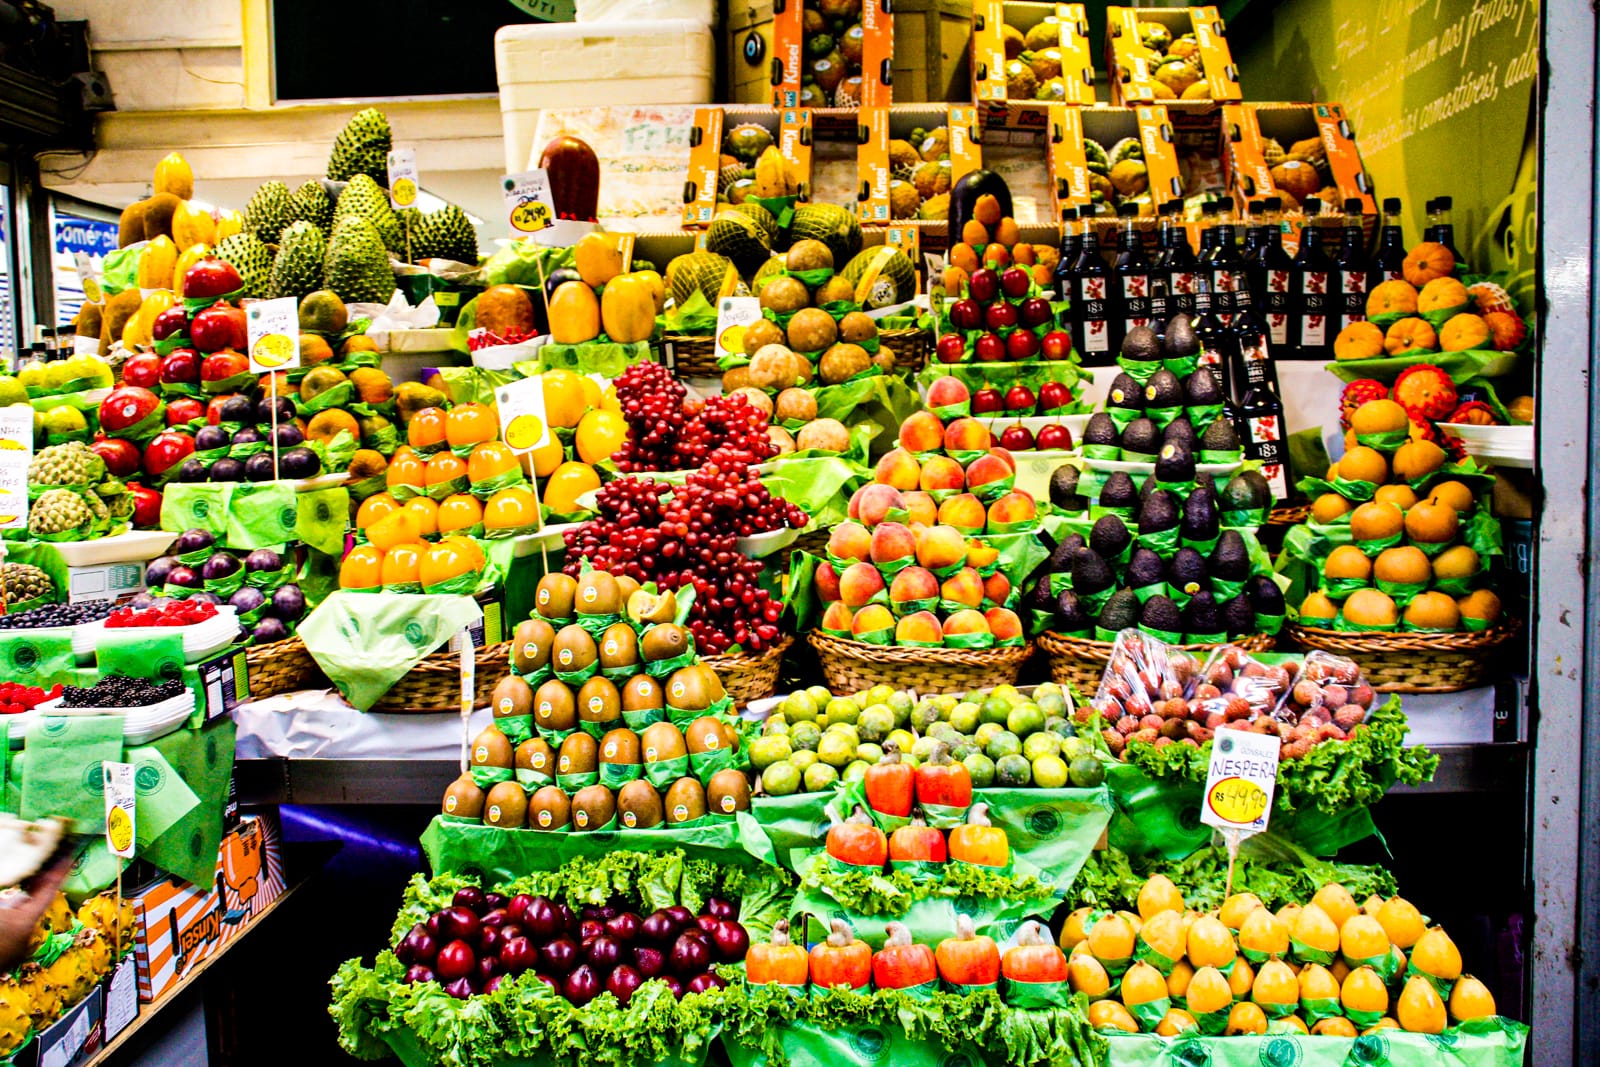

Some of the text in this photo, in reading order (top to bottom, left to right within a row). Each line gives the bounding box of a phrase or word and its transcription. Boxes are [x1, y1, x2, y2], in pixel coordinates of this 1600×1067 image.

[783, 43, 799, 84] Kinsei
[698, 168, 715, 202] Kinsei
[871, 166, 888, 199] Kinsei
[1211, 757, 1277, 779] NESPERA
[1226, 783, 1268, 815] 49,90
[181, 909, 222, 962] Kinsei
